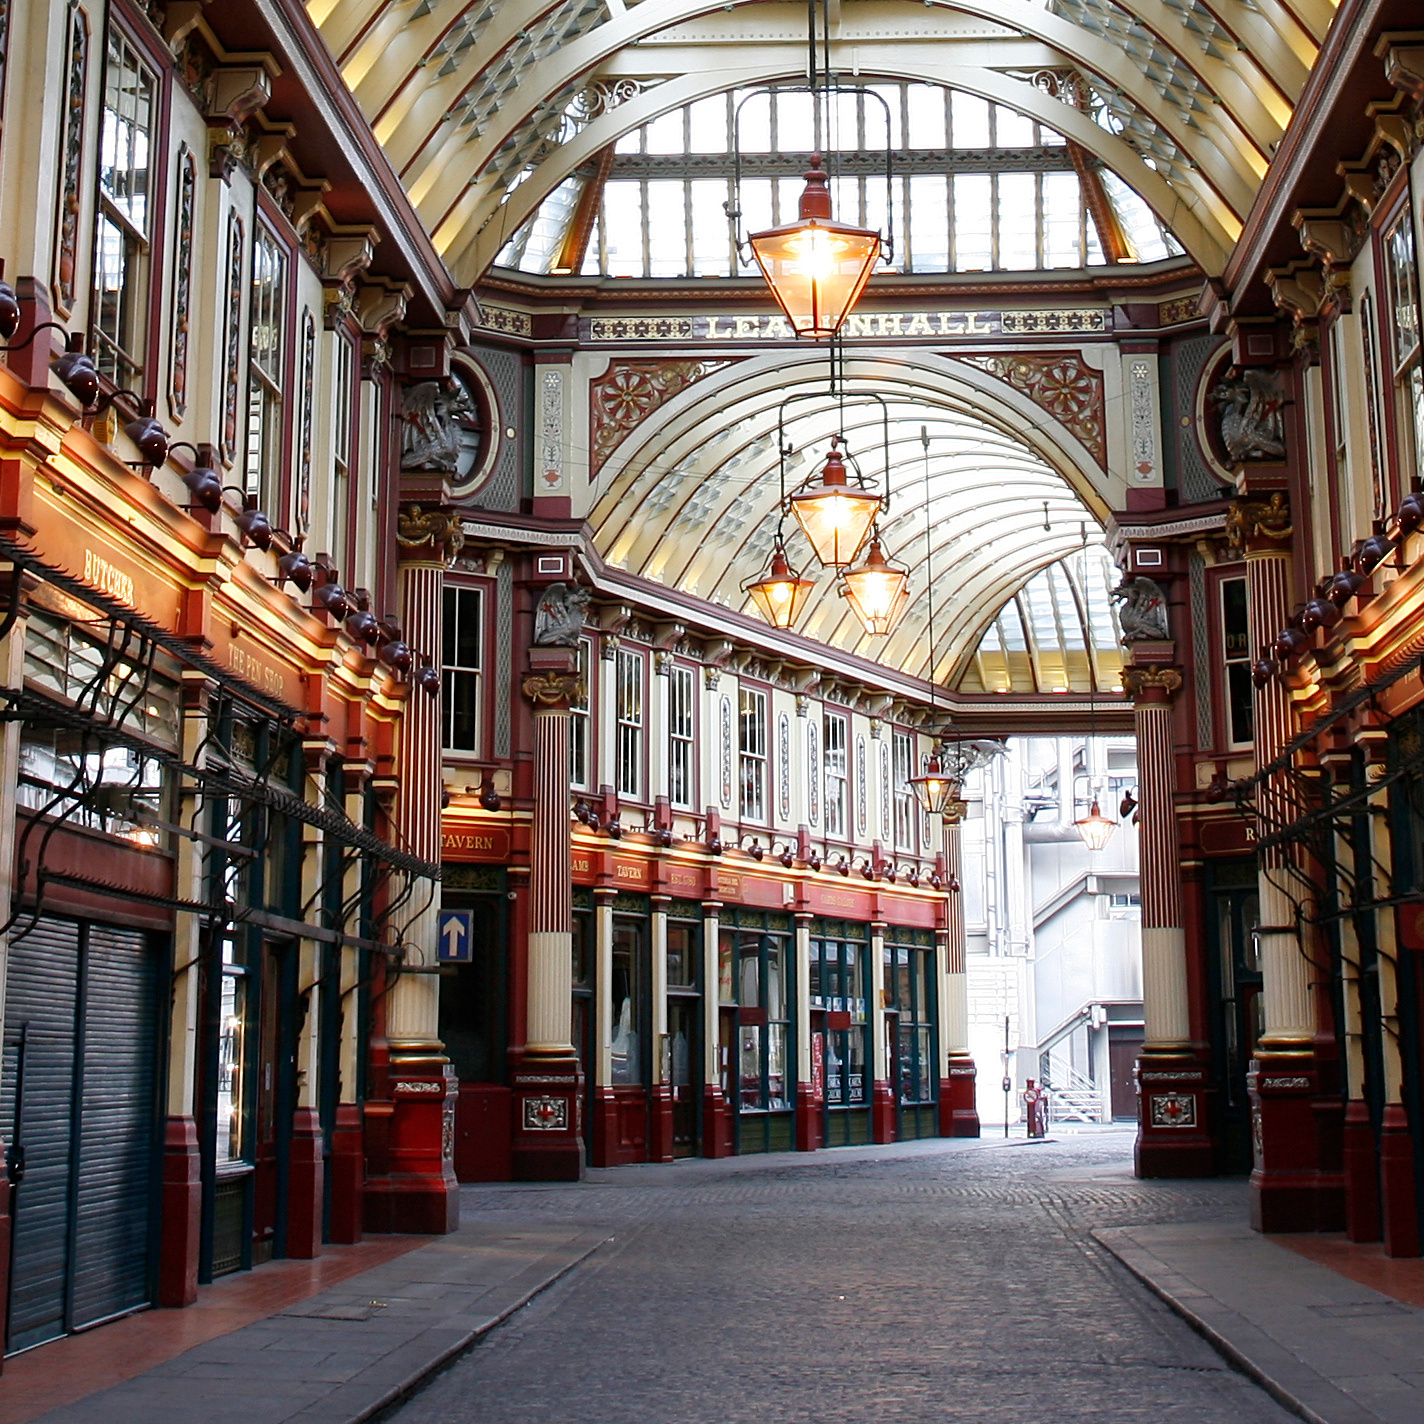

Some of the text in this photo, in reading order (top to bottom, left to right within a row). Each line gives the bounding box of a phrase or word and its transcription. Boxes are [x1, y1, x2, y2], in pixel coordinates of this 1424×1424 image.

[84, 548, 134, 607] BUTCHER
[228, 642, 244, 674] THE
[441, 835, 493, 850] TAVERN
